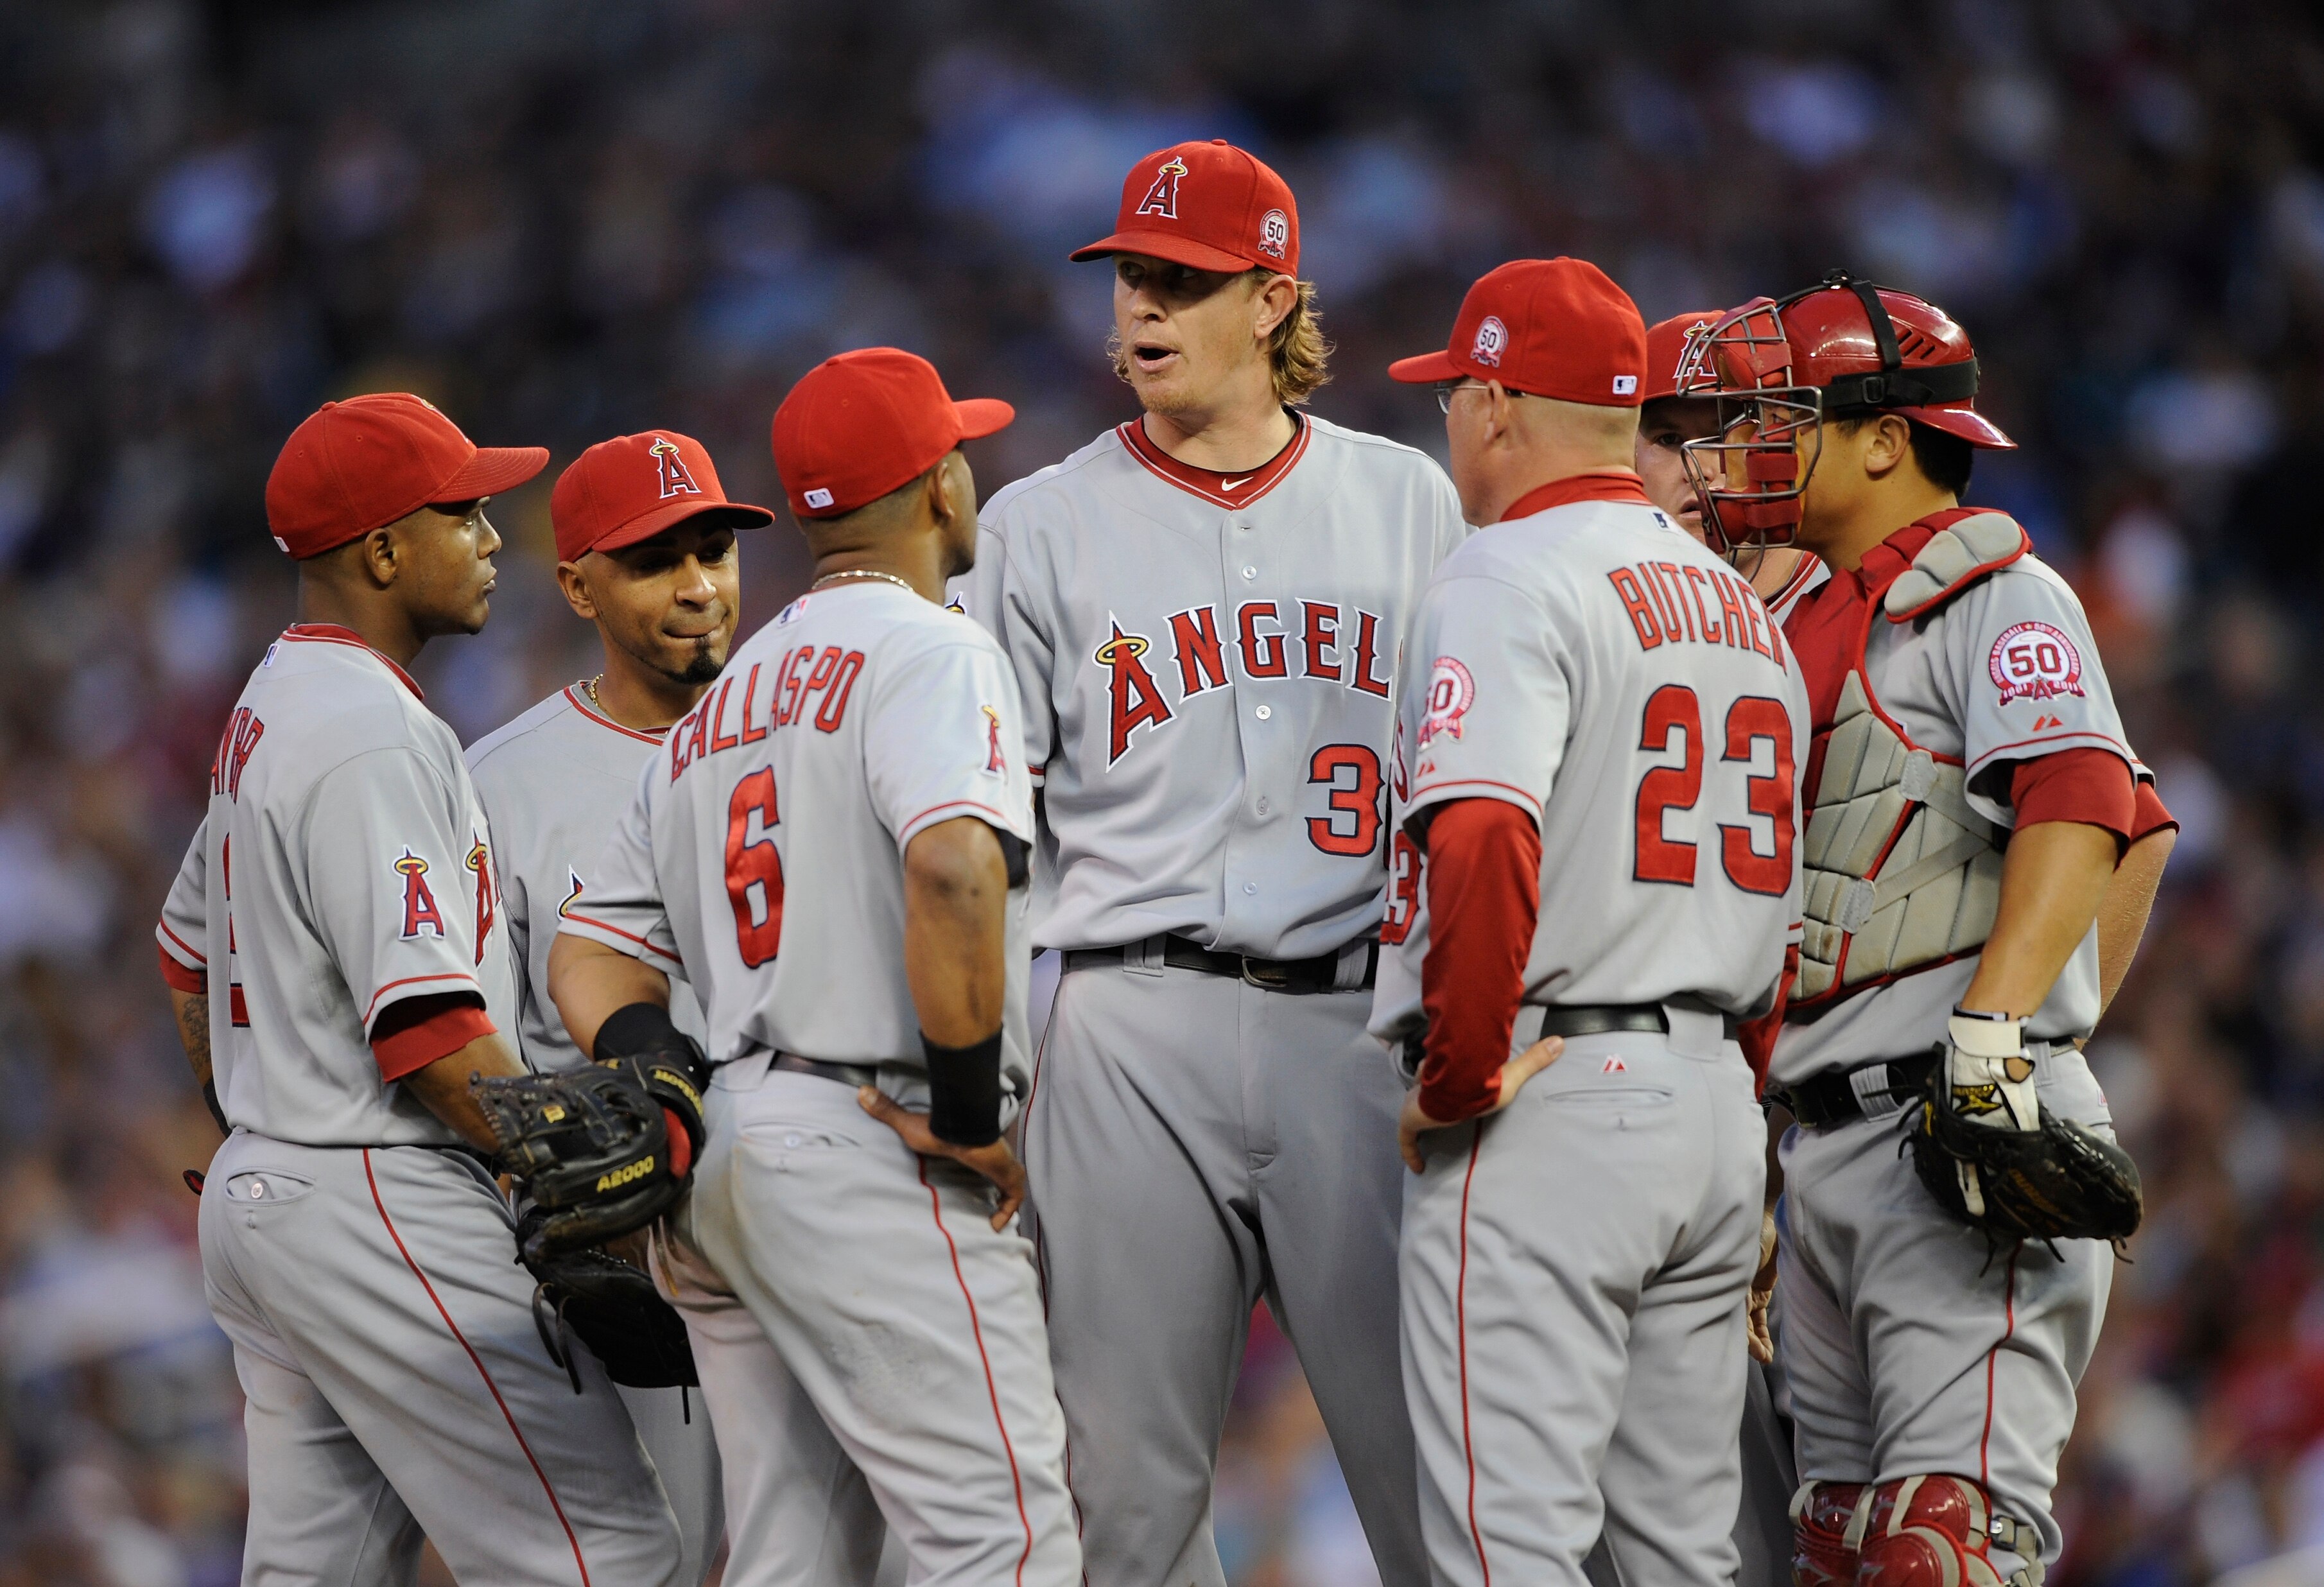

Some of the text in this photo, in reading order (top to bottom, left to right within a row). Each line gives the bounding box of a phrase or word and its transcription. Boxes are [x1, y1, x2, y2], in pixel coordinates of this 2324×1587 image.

[1136, 156, 1188, 219] A
[1268, 220, 1283, 241] 50
[1481, 329, 1496, 348] 50
[649, 438, 702, 499] A
[1092, 597, 1393, 773] ANGEL
[2008, 643, 2062, 677] 50
[1304, 743, 1387, 859] 3
[1633, 684, 1796, 898] 23
[393, 846, 444, 939] A
[725, 764, 785, 970] 6
[1379, 829, 1423, 945] 3
[596, 1154, 655, 1193] A2000
